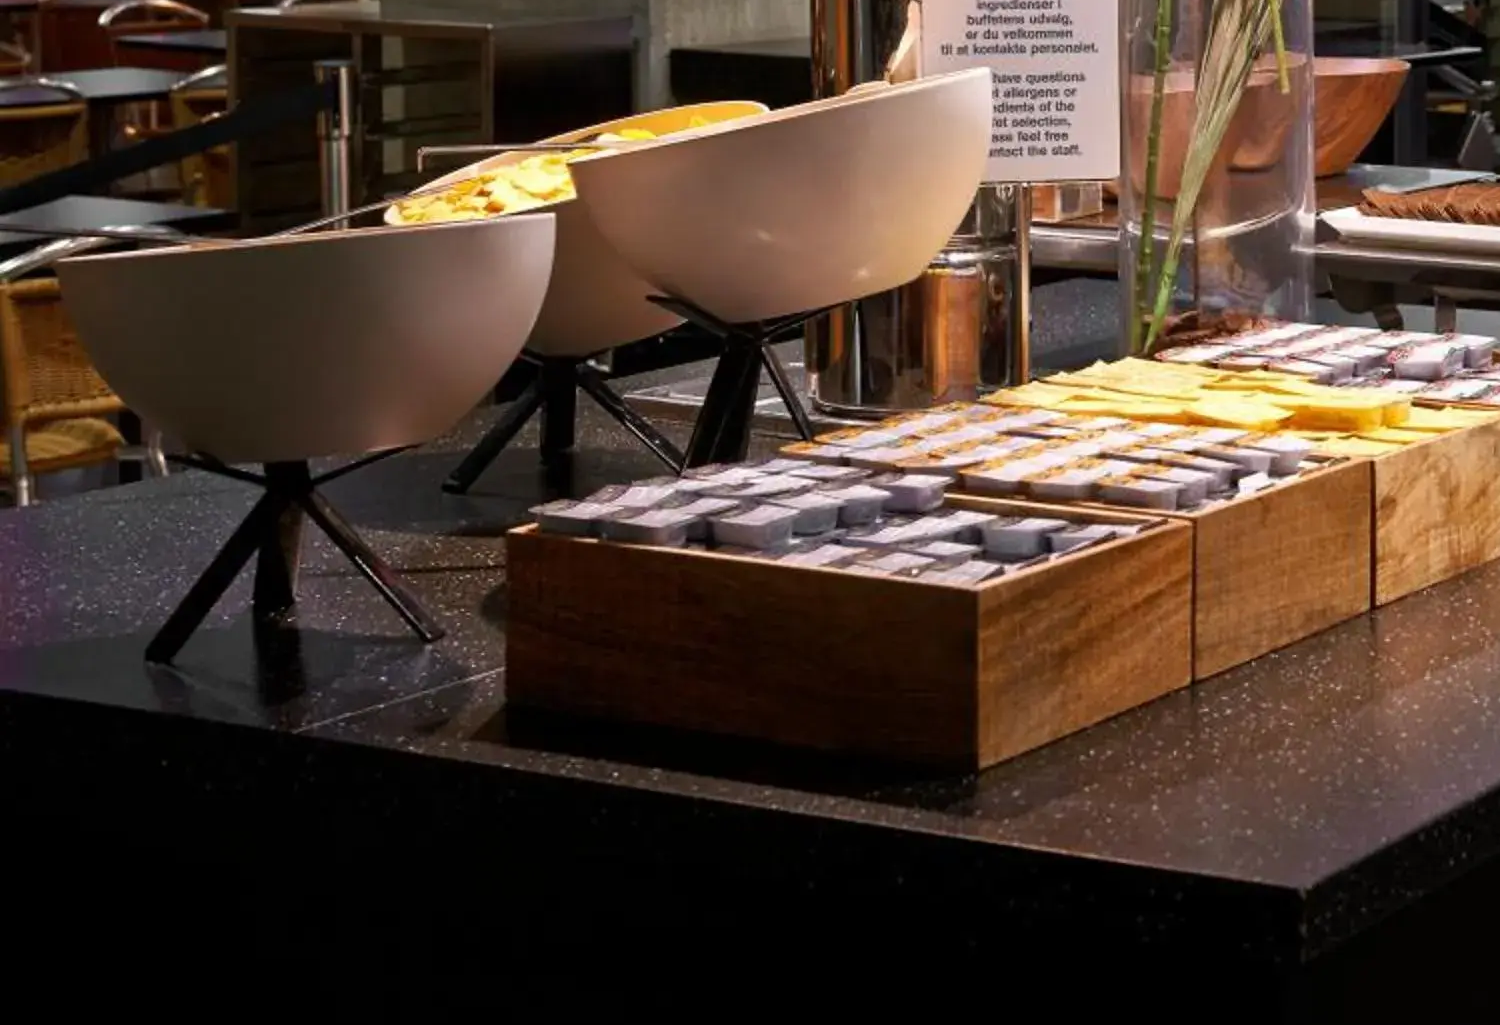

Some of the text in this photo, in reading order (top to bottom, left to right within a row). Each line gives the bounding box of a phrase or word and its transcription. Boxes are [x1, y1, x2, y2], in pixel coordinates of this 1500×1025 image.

[976, 0, 1054, 12] ingredienser
[965, 28, 1073, 39] er du velkommen
[941, 43, 953, 55] til
[956, 44, 968, 55] at
[973, 43, 1026, 55] kontakte
[1026, 71, 1086, 85] questions
[1003, 87, 1059, 99] allergens
[1064, 87, 1077, 97] or
[993, 100, 1075, 113] dients of the
[1017, 131, 1040, 141] feel
[1044, 131, 1068, 141] free
[989, 146, 1023, 157] ntact
[1028, 145, 1047, 156] the
